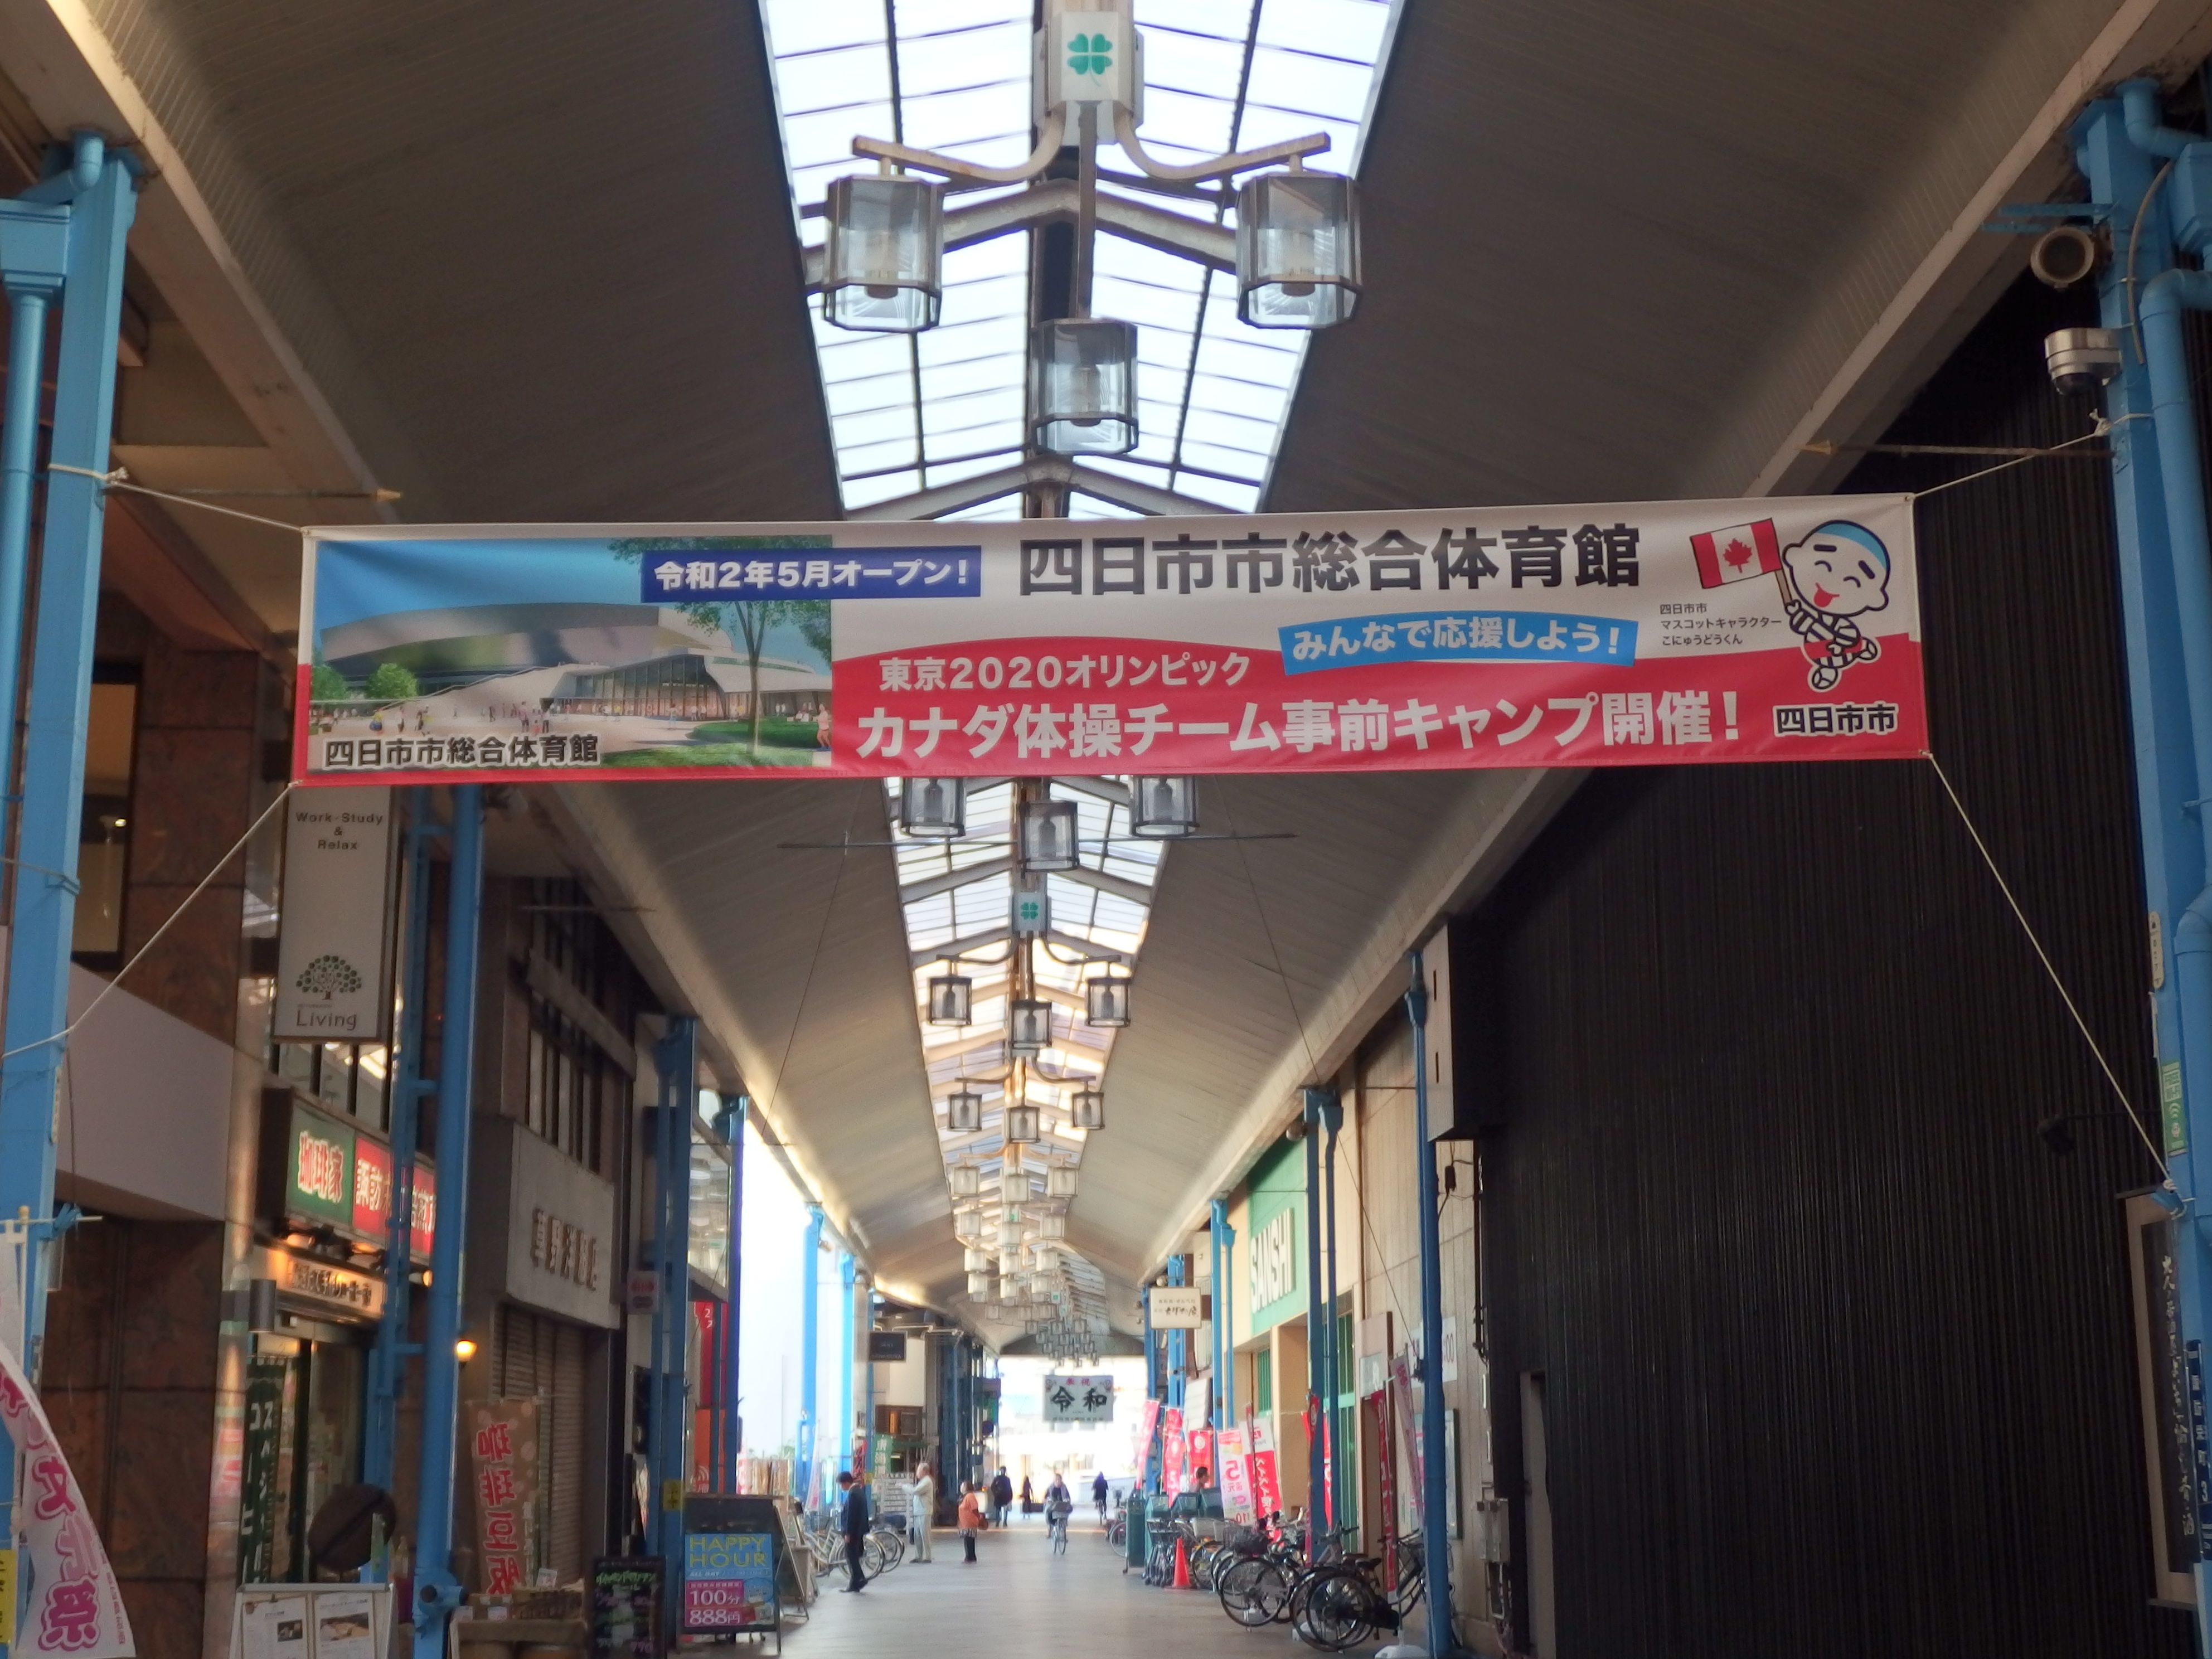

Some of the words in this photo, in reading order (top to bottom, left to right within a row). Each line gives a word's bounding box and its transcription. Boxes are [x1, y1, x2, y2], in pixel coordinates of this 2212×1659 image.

[1020, 523, 1640, 596] 四日市市総合体育館
[1659, 602, 1707, 615] 四日市市
[1660, 617, 1782, 630] マスコットキャラクター
[1661, 633, 1743, 647] こにゅうどうくん
[879, 652, 1251, 692] 東京2020オリンピック
[1776, 702, 1897, 736] 四日市市
[324, 734, 599, 768] 四日市市総合体育館
[334, 826, 343, 836] &
[317, 839, 358, 851] Relax
[296, 1010, 357, 1031] Living
[1250, 1207, 1296, 1314] SANSHI
[1050, 1385, 1108, 1413] 令和
[689, 1536, 766, 1551] HAPPY
[689, 1553, 767, 1569] HOUR
[690, 1589, 741, 1605] 100分
[689, 1609, 741, 1625] 888円
